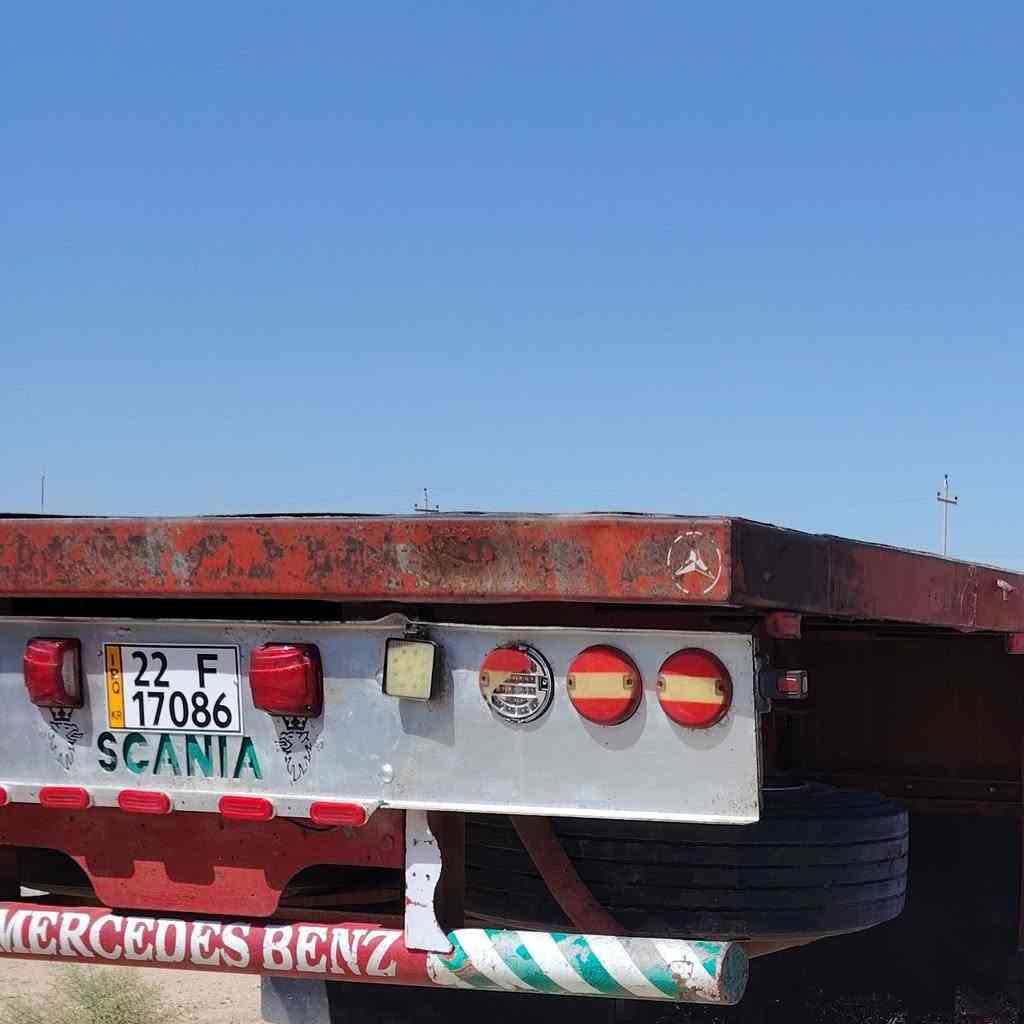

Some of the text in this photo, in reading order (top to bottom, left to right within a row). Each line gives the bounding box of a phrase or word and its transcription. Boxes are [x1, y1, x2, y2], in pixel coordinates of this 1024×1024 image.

[132, 651, 218, 688] 22 F
[132, 691, 232, 728] 17086
[97, 731, 264, 779] SCANIA
[0, 908, 402, 977] MERCEDES BENZ
